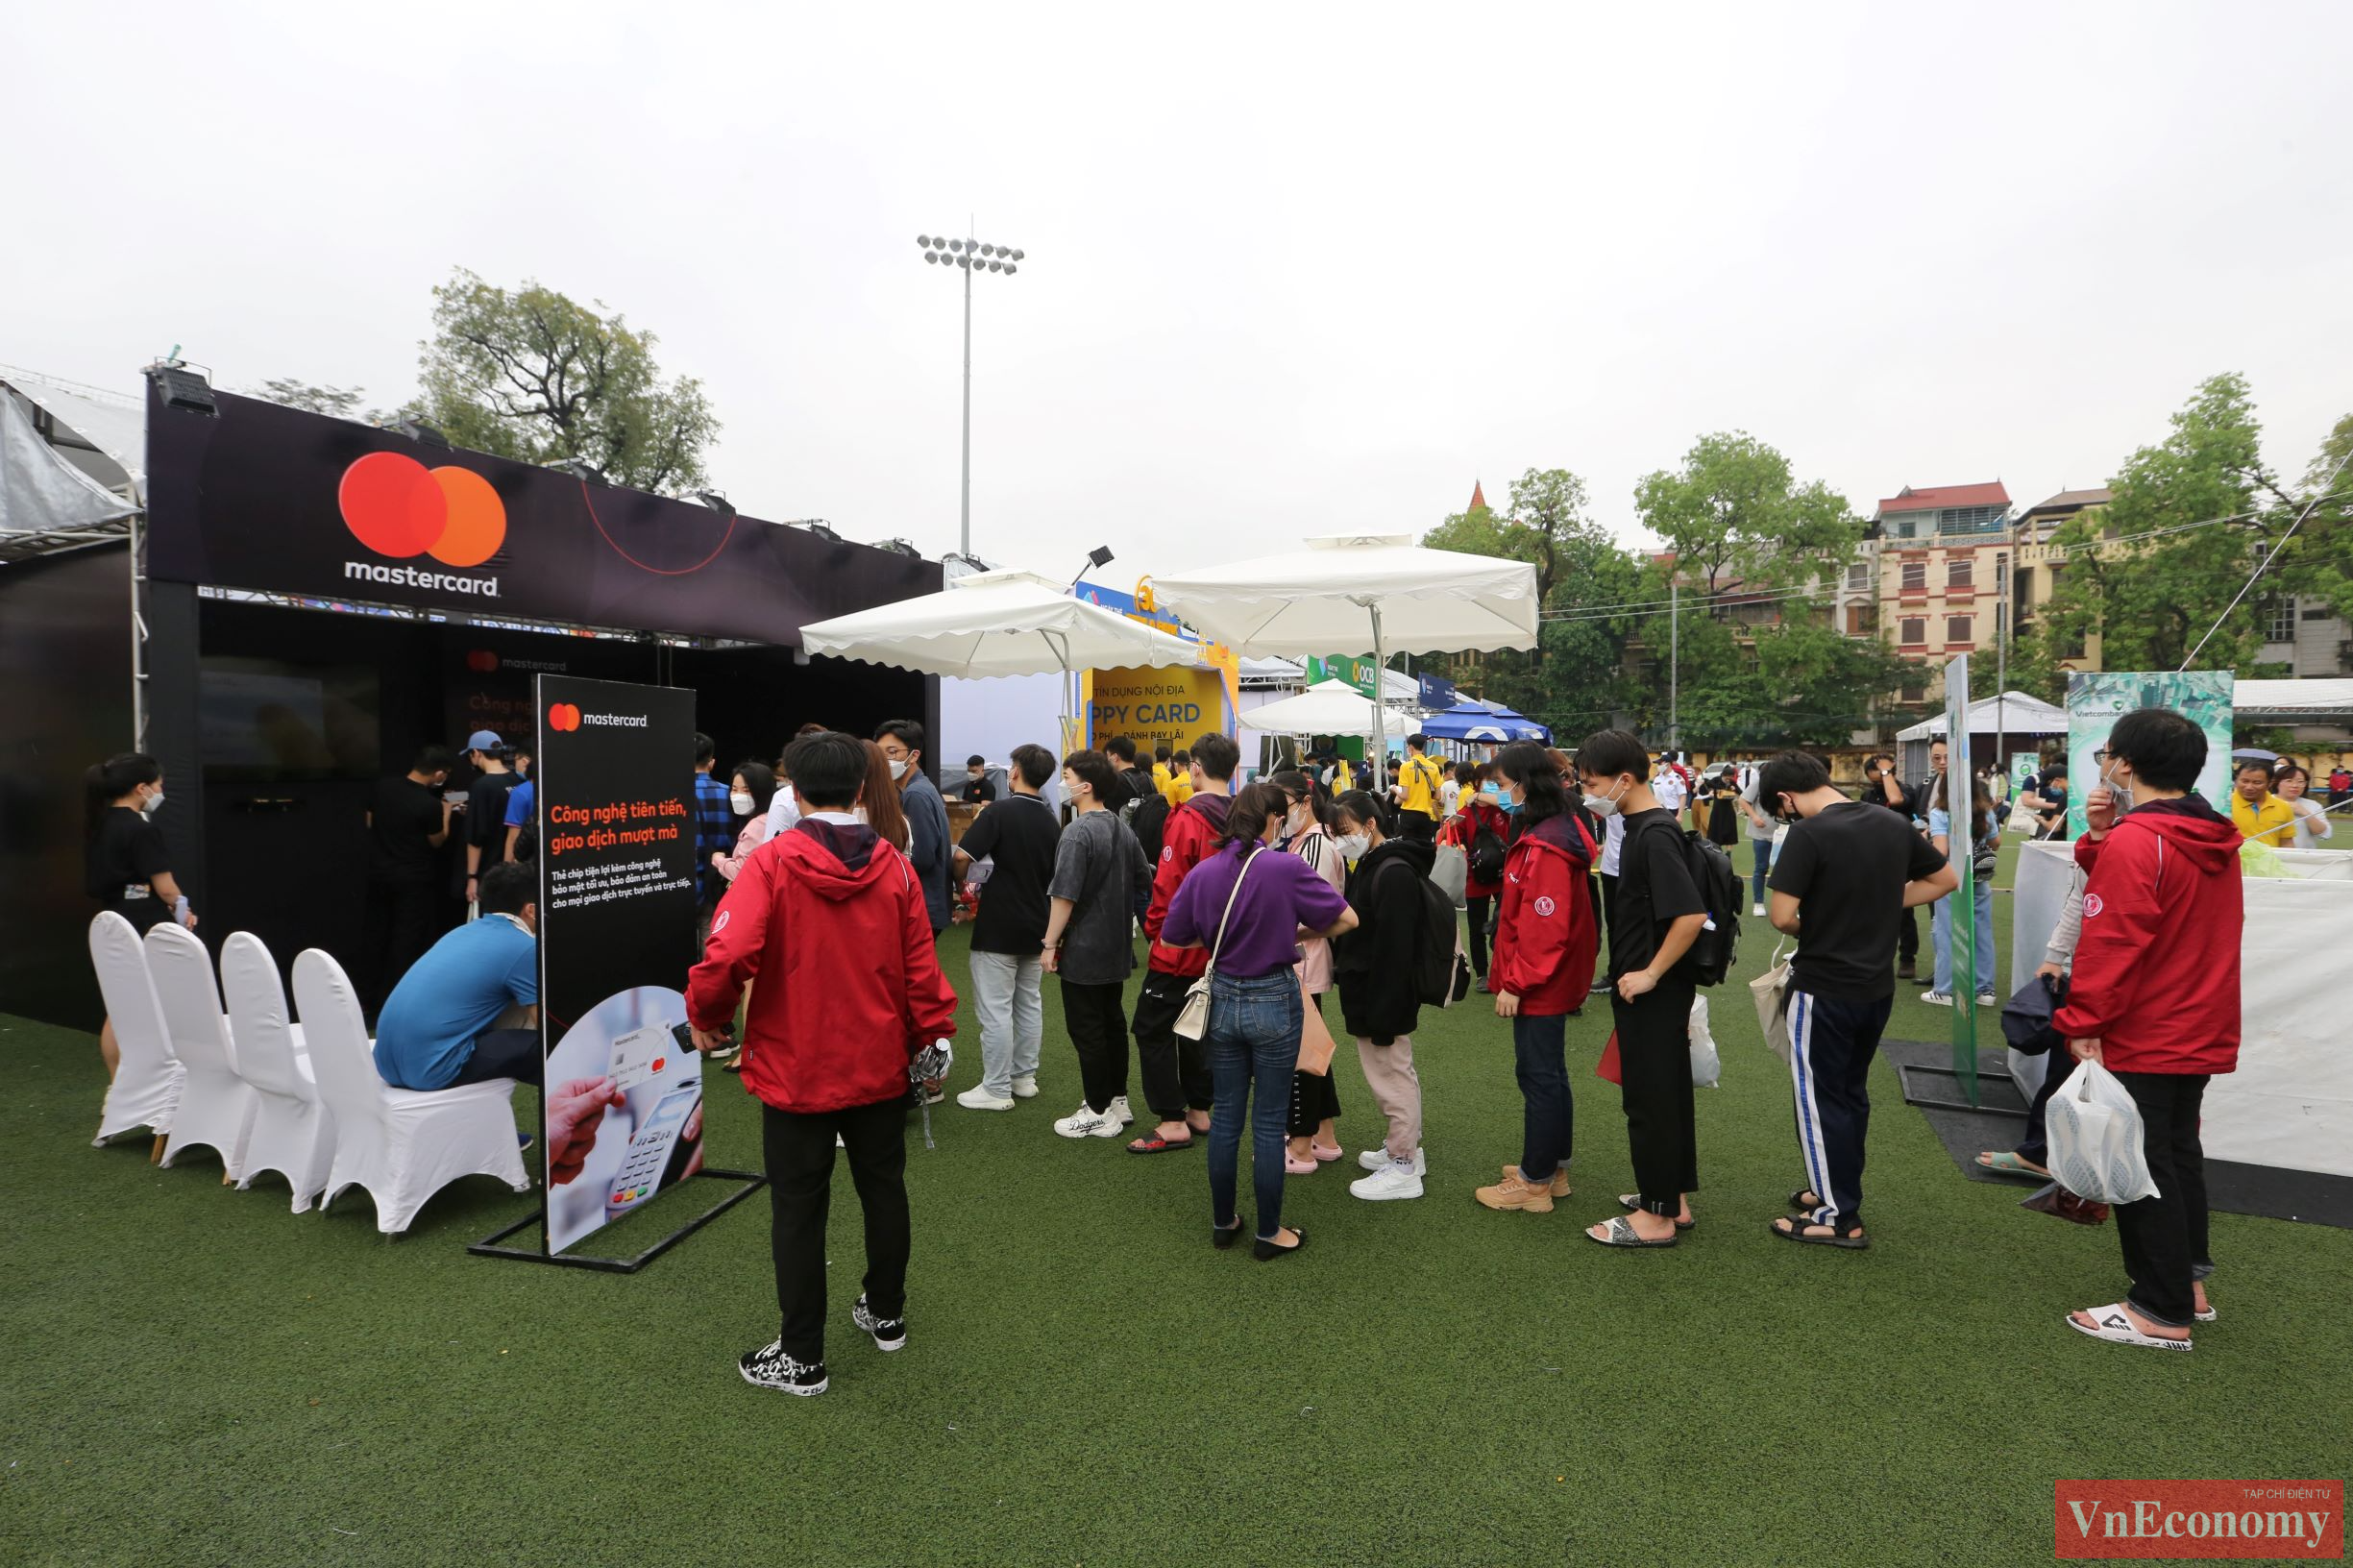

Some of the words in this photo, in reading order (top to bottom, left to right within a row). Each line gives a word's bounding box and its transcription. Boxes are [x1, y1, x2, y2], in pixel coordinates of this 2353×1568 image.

[345, 561, 499, 597] mastercard
[502, 658, 567, 671] mastercard
[1360, 665, 1374, 683] OCB
[1112, 686, 1142, 698] DỤNG
[1144, 684, 1165, 698] NỘI
[1166, 685, 1185, 697] ĐỊA
[583, 714, 647, 727] mastercard
[1136, 703, 1200, 723] CARD
[1169, 729, 1184, 739] LÃI
[551, 805, 590, 825] Công
[594, 802, 627, 823] nghệ
[630, 800, 655, 818] tiên
[658, 797, 687, 817] tiến,
[551, 832, 583, 855] giao
[587, 828, 616, 851] dịch
[620, 828, 655, 845] mượt
[658, 823, 677, 840] mà
[551, 869, 566, 881] Thẻ
[568, 867, 583, 880] chip
[584, 865, 600, 878] tiện
[601, 864, 610, 875] lợi
[611, 862, 626, 873] kèm
[627, 861, 644, 871] công
[645, 858, 661, 870] nghệ
[569, 881, 584, 894] mật
[651, 870, 667, 879] toàn
[552, 897, 567, 909] cho
[568, 894, 583, 907] mọi
[584, 893, 601, 905] giao
[601, 890, 617, 902] dịch
[618, 889, 633, 900] trực
[634, 884, 653, 896] tuyến
[654, 881, 662, 892] và
[663, 881, 676, 892] trực
[1069, 1119, 1104, 1134] Dodgers
